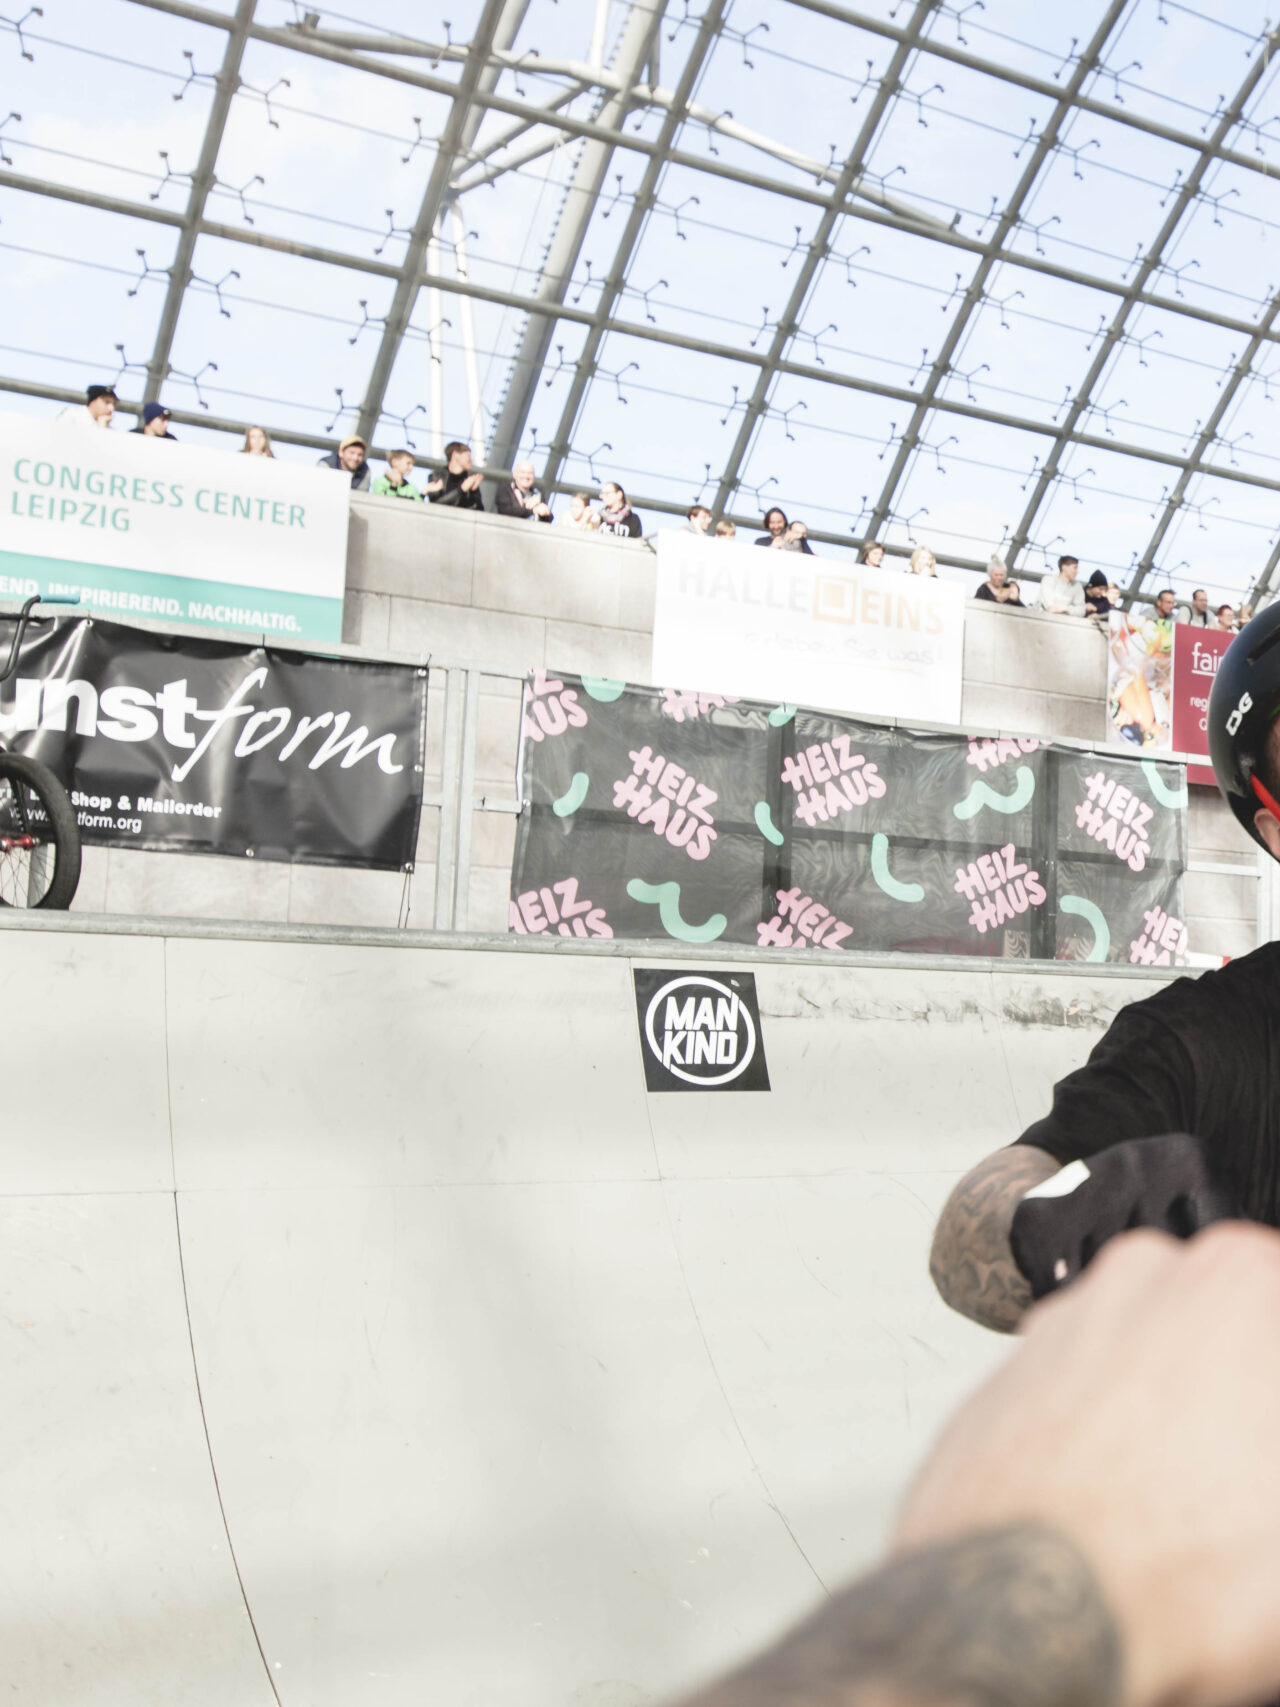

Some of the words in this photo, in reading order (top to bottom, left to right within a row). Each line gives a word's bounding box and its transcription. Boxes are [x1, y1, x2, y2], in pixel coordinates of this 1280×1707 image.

[11, 491, 131, 532] LEIPZIG
[14, 458, 184, 508] CONGRESS
[194, 488, 306, 528] CENTER
[188, 600, 302, 632] NACHHALTIG.
[678, 556, 809, 613] HALLE
[860, 585, 945, 636] EINS
[628, 746, 718, 825] HEIZ
[781, 733, 865, 791] HEIZ
[71, 791, 112, 811] Shop
[117, 795, 131, 811] &
[137, 797, 222, 818] Mailorder
[612, 774, 718, 861] HAUS
[796, 763, 887, 827] HAUS
[1085, 772, 1154, 841] HEIZ
[1075, 799, 1151, 872] HAUS
[954, 843, 1028, 900] HEIZ
[968, 871, 1047, 933] HAUS
[664, 991, 740, 1031] MAN
[662, 1031, 738, 1070] KIND
